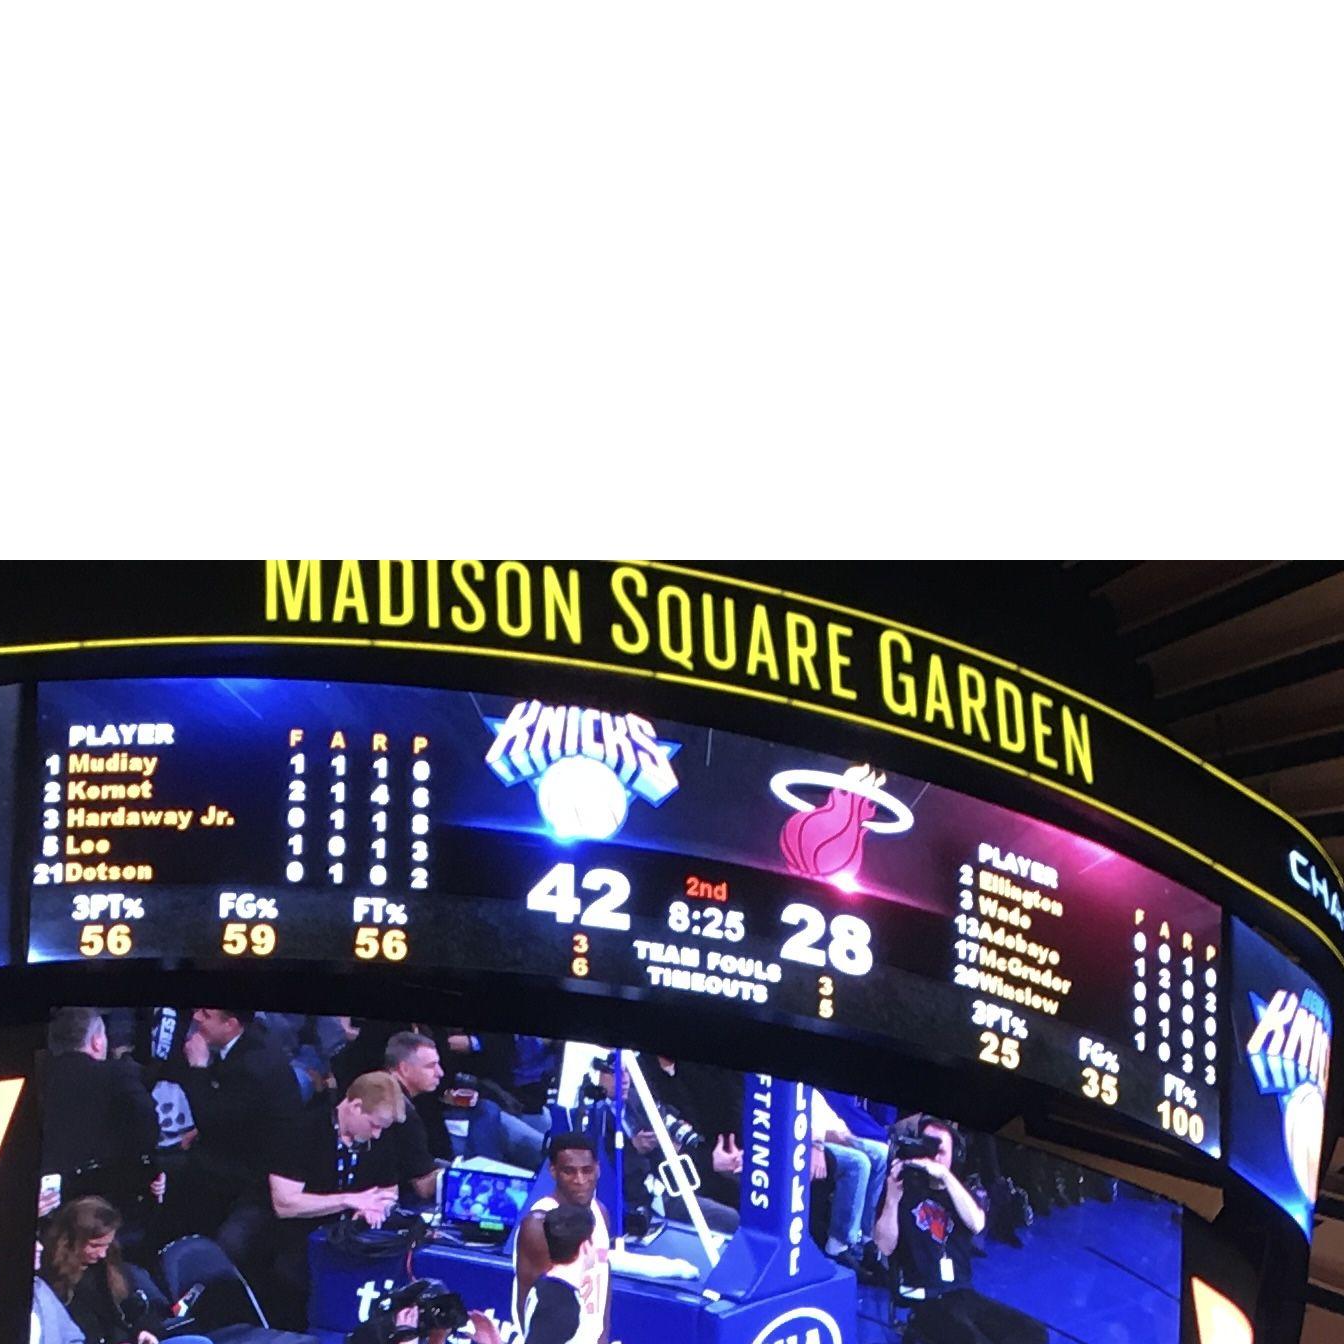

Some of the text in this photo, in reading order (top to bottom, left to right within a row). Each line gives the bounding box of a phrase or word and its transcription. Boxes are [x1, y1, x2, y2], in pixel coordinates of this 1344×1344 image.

[264, 560, 1095, 785] MADISON SQUARE GARDEN
[69, 723, 175, 747] PLAYER
[485, 699, 679, 804] KNICKS
[45, 753, 157, 777] 1 Mudiay
[43, 781, 61, 803] 2
[43, 806, 235, 831] 3 Hardaway Jr.
[33, 863, 152, 884] 21 Dotson
[978, 843, 1059, 888] PLAYER
[685, 875, 728, 902] 2nd
[72, 893, 408, 925] 3PT% FG% FT%
[527, 862, 873, 976] 42 28
[668, 901, 745, 941] 8:25
[80, 924, 407, 961] 56 59 56
[573, 934, 833, 996] 3 TEAM FOULS 3
[572, 956, 833, 1018] 6 TIMEOUTS 5
[972, 1000, 1197, 1109] 3PT% FG% FT%
[979, 1031, 1204, 1144] 25 35 100
